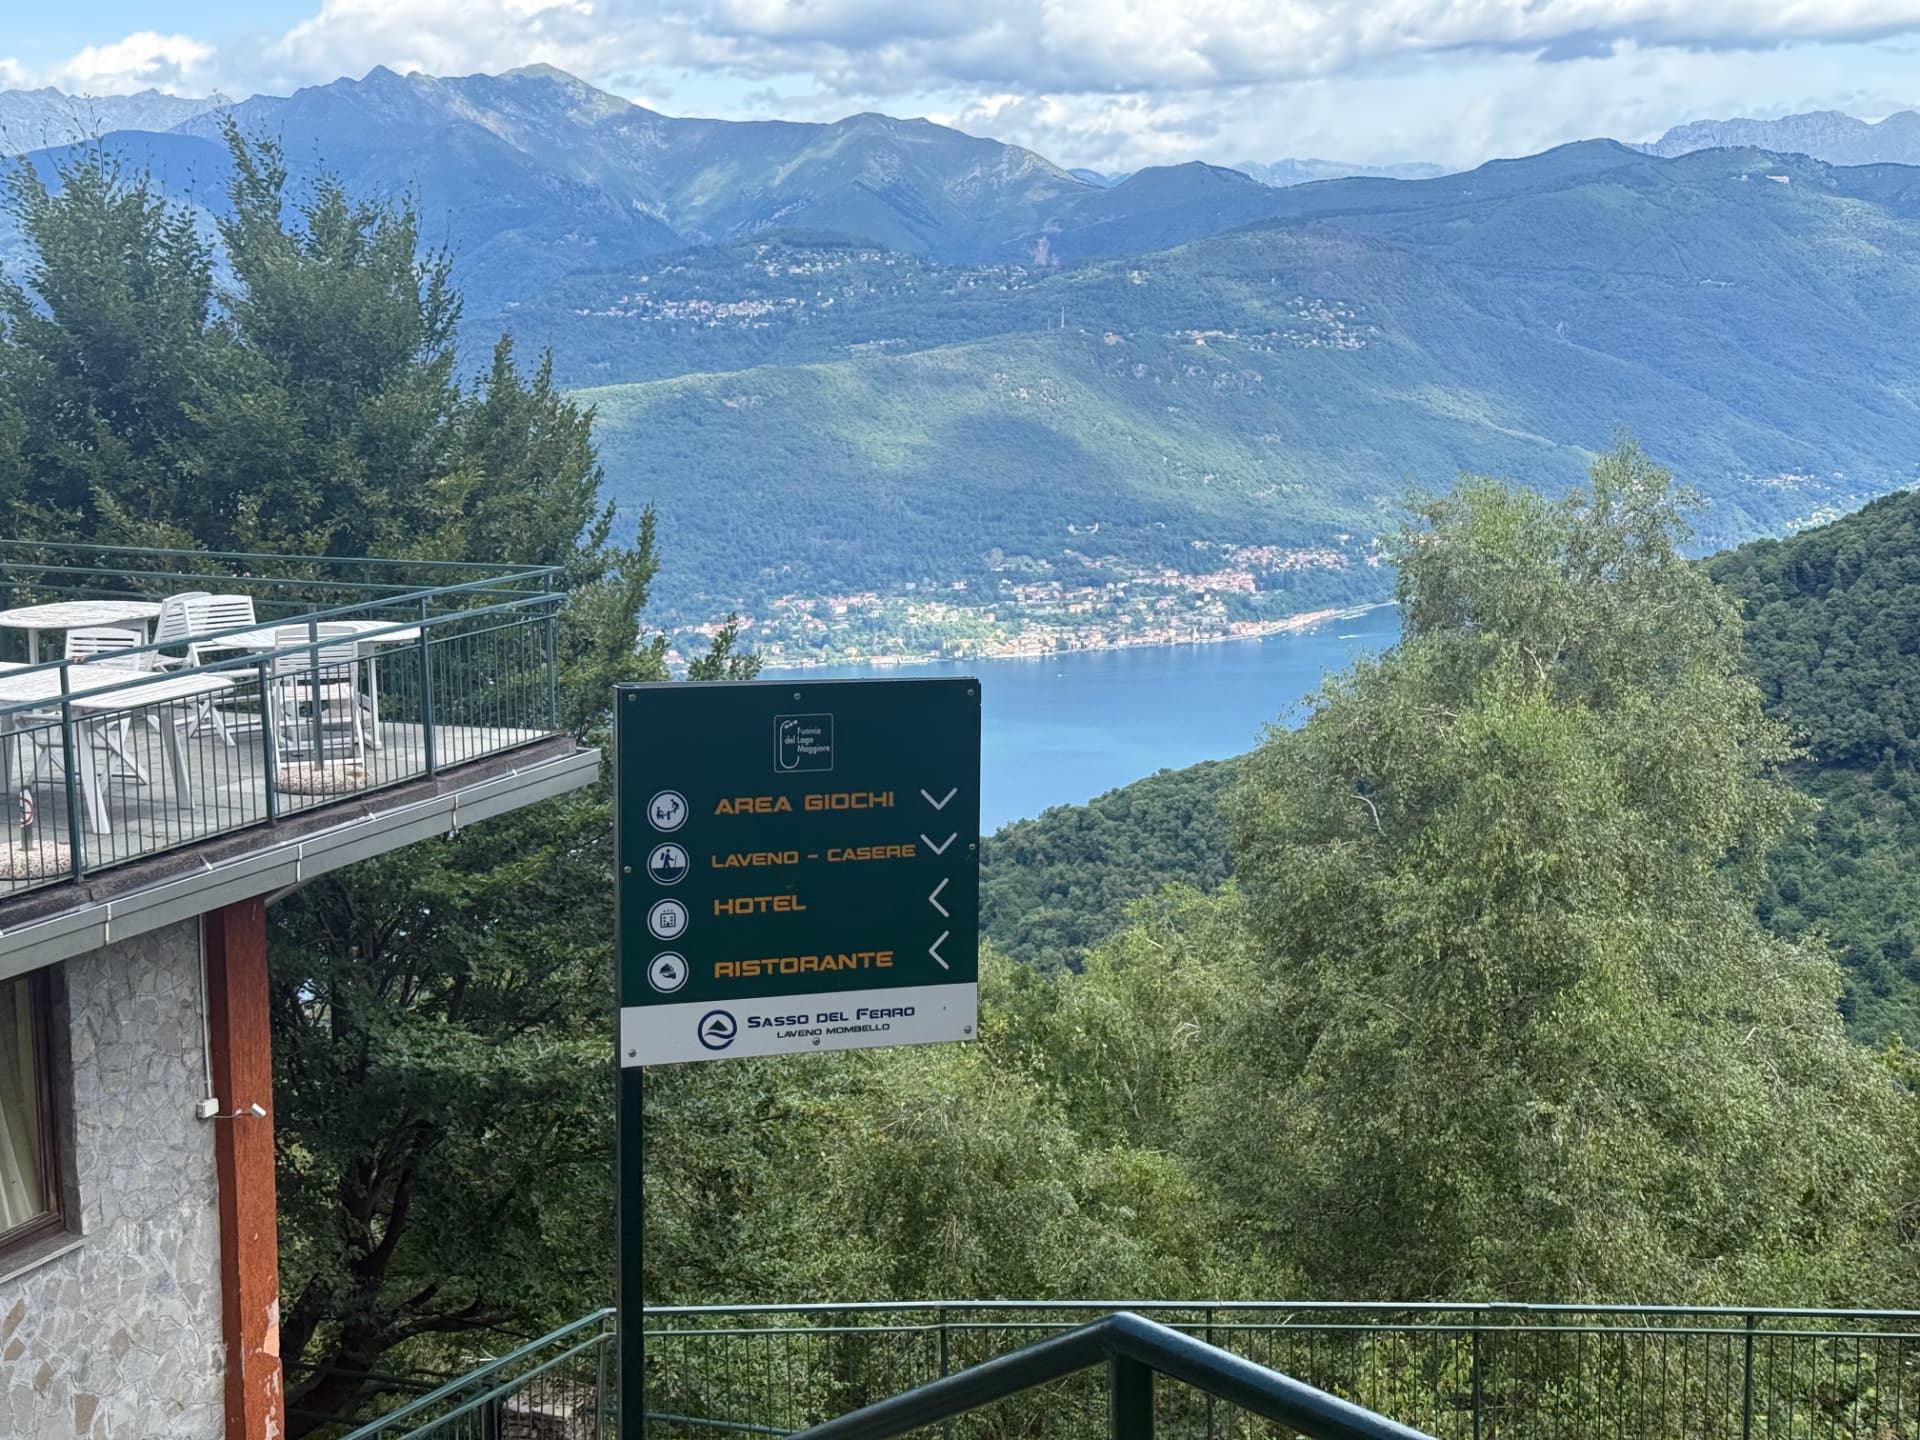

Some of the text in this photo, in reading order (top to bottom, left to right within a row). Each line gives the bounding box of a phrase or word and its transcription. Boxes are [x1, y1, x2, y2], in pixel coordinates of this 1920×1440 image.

[784, 734, 814, 746] del Lago
[797, 743, 830, 755] Maggiore
[715, 791, 894, 815] AREA GIOCHI
[711, 850, 799, 868] LAVENO
[827, 844, 916, 863] CASERE
[714, 895, 807, 916] HOTEL
[714, 951, 894, 979] RISTORANTE
[776, 1023, 890, 1039] LAVENO MOMBELLO
